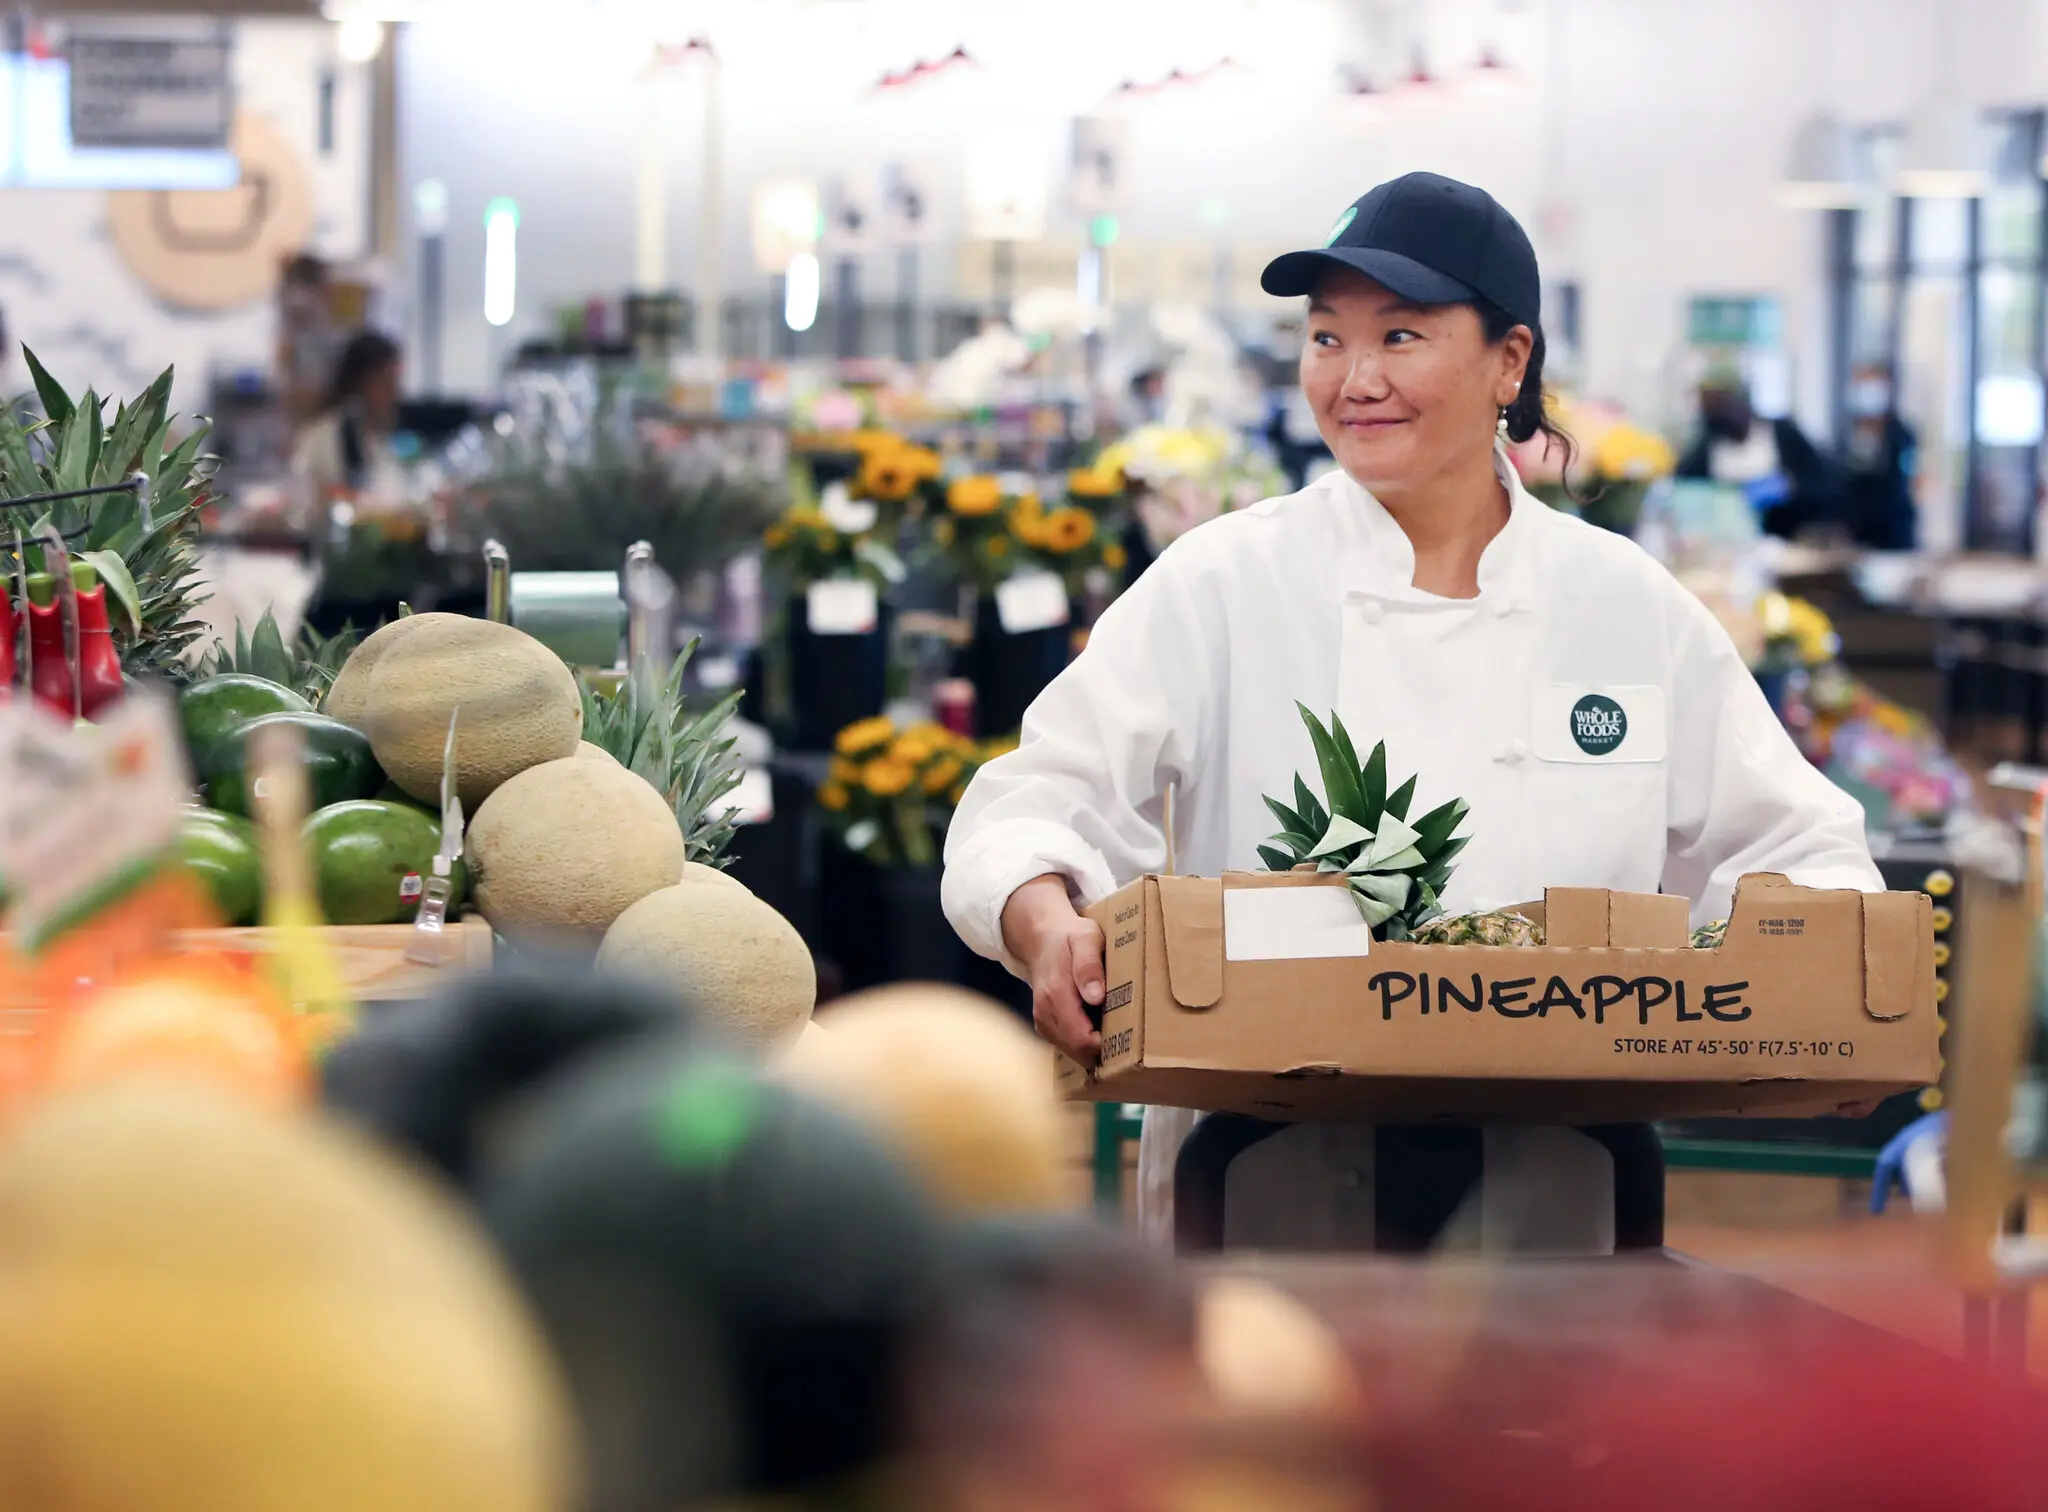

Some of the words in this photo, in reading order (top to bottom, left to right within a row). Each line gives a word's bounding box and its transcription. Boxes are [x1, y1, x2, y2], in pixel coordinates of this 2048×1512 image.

[1575, 710, 1622, 724] WHOLE
[1577, 723, 1620, 737] FOODS
[1367, 971, 1752, 1024] PINEAPPLE
[1614, 1038, 1667, 1053] STORE
[1671, 1039, 1693, 1054] AT
[1838, 1041, 1854, 1058] C)
